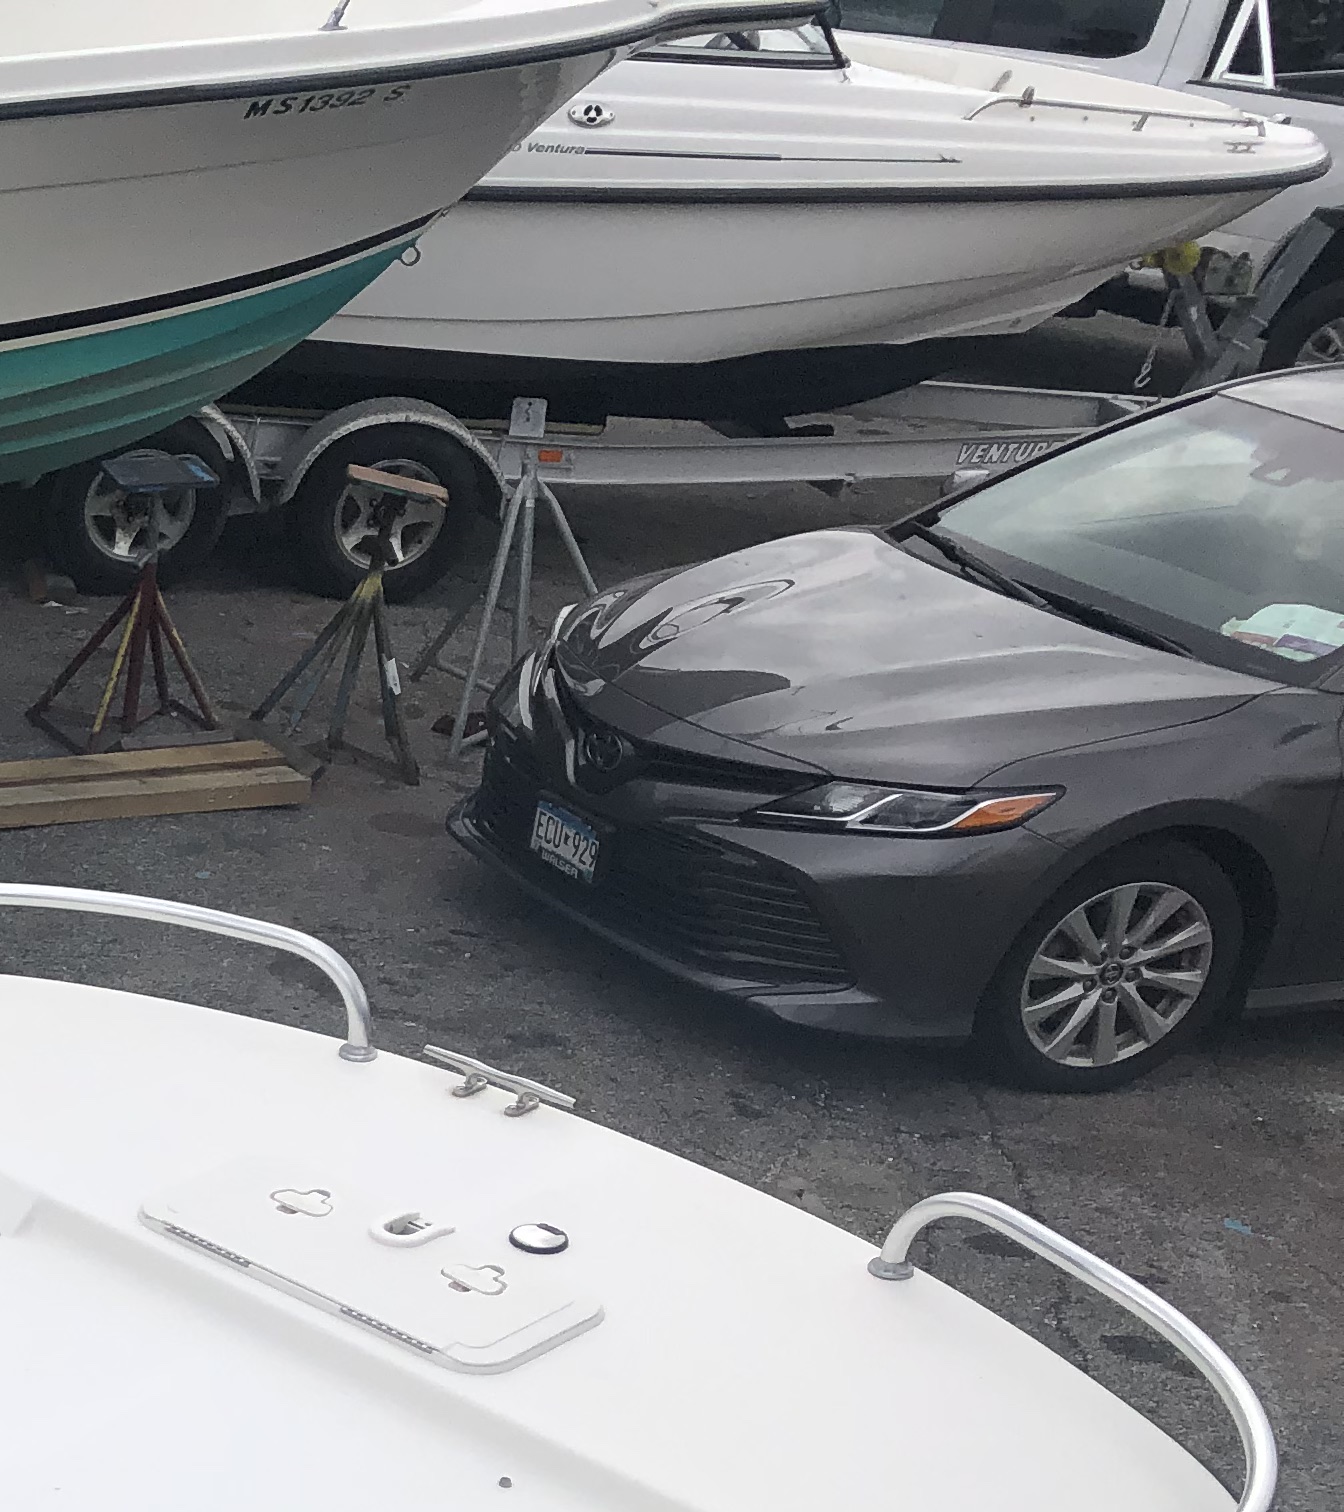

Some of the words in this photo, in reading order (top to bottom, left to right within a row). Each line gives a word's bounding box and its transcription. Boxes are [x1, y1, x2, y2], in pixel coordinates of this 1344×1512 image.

[527, 142, 586, 154] Ventura
[956, 441, 1064, 464] VENTUR
[572, 831, 599, 868] 929
